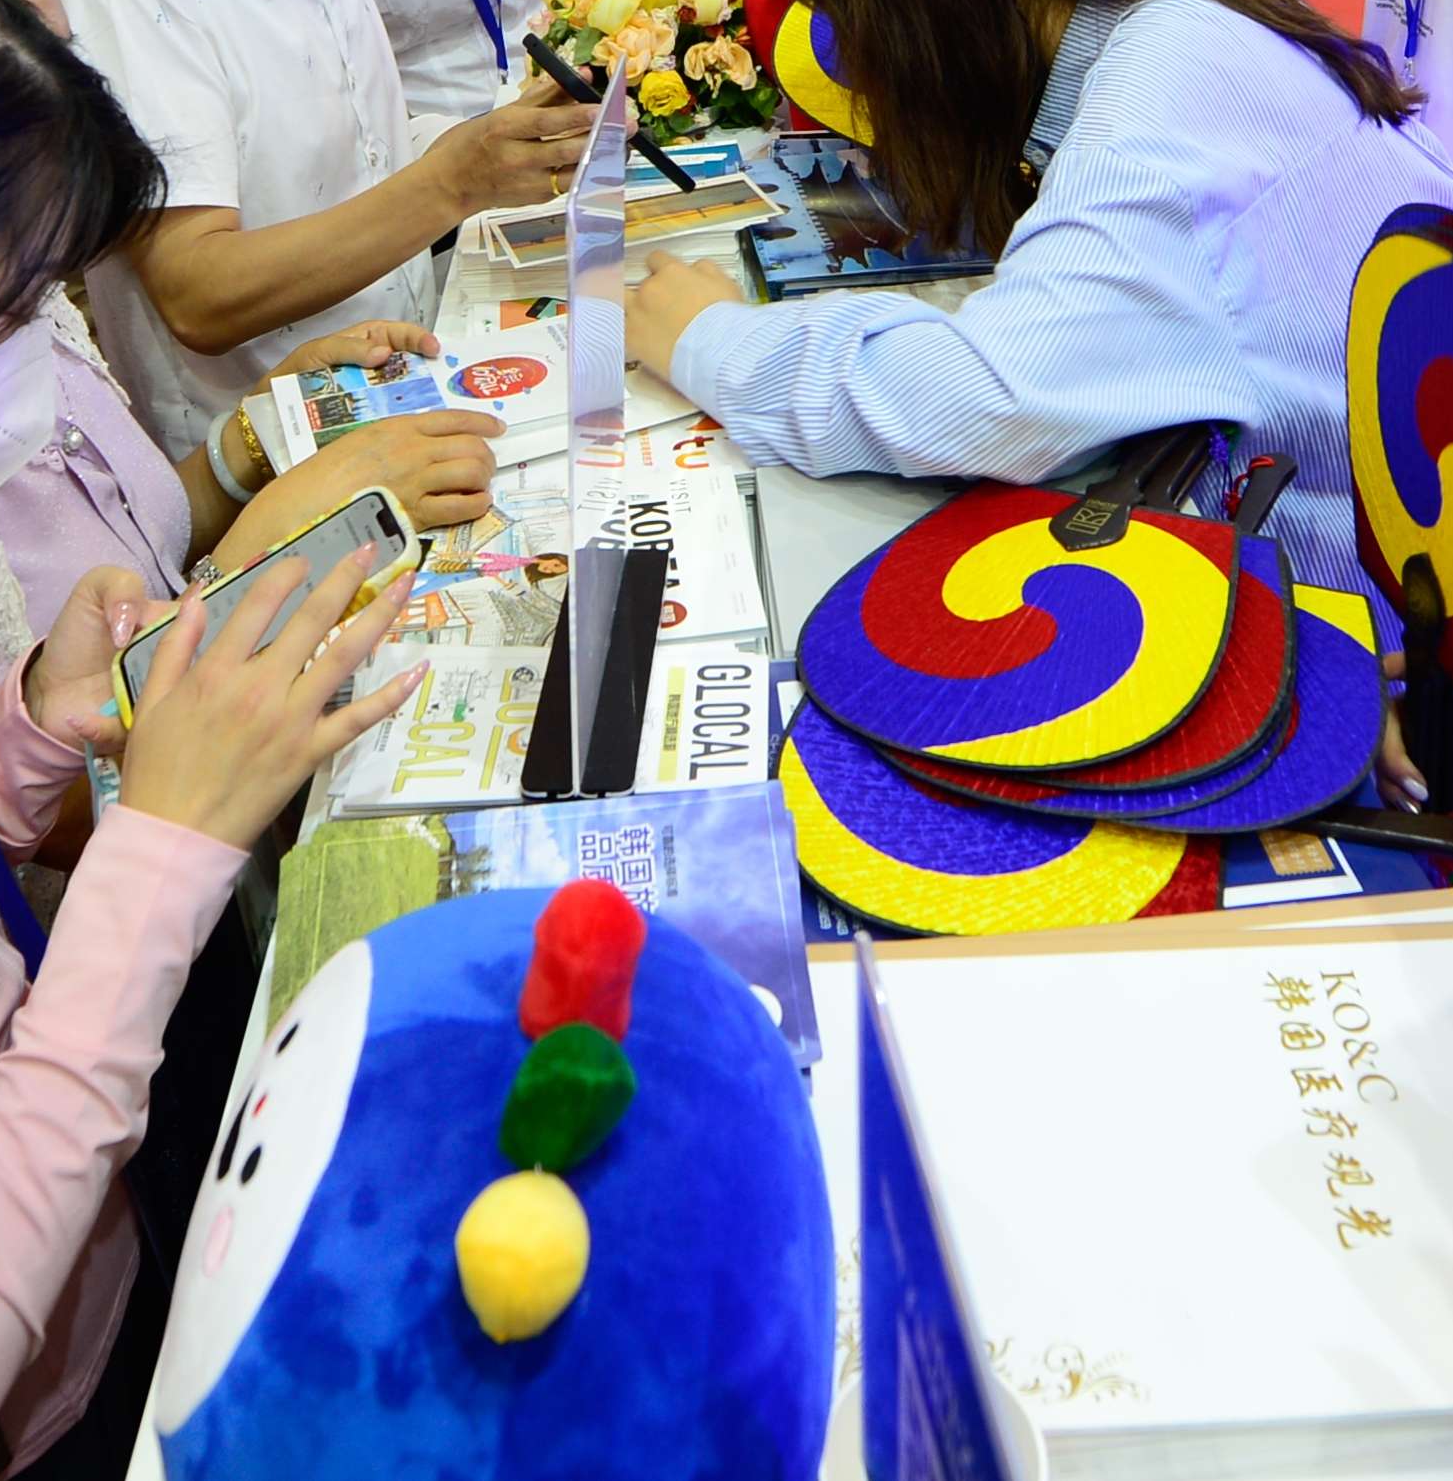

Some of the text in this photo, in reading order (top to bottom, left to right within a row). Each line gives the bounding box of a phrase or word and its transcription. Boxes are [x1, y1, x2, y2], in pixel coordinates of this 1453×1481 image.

[669, 478, 692, 514] VISIT
[391, 720, 477, 794] CAL
[689, 664, 753, 781] GLOCAL
[1319, 969, 1399, 1105] KO&C
